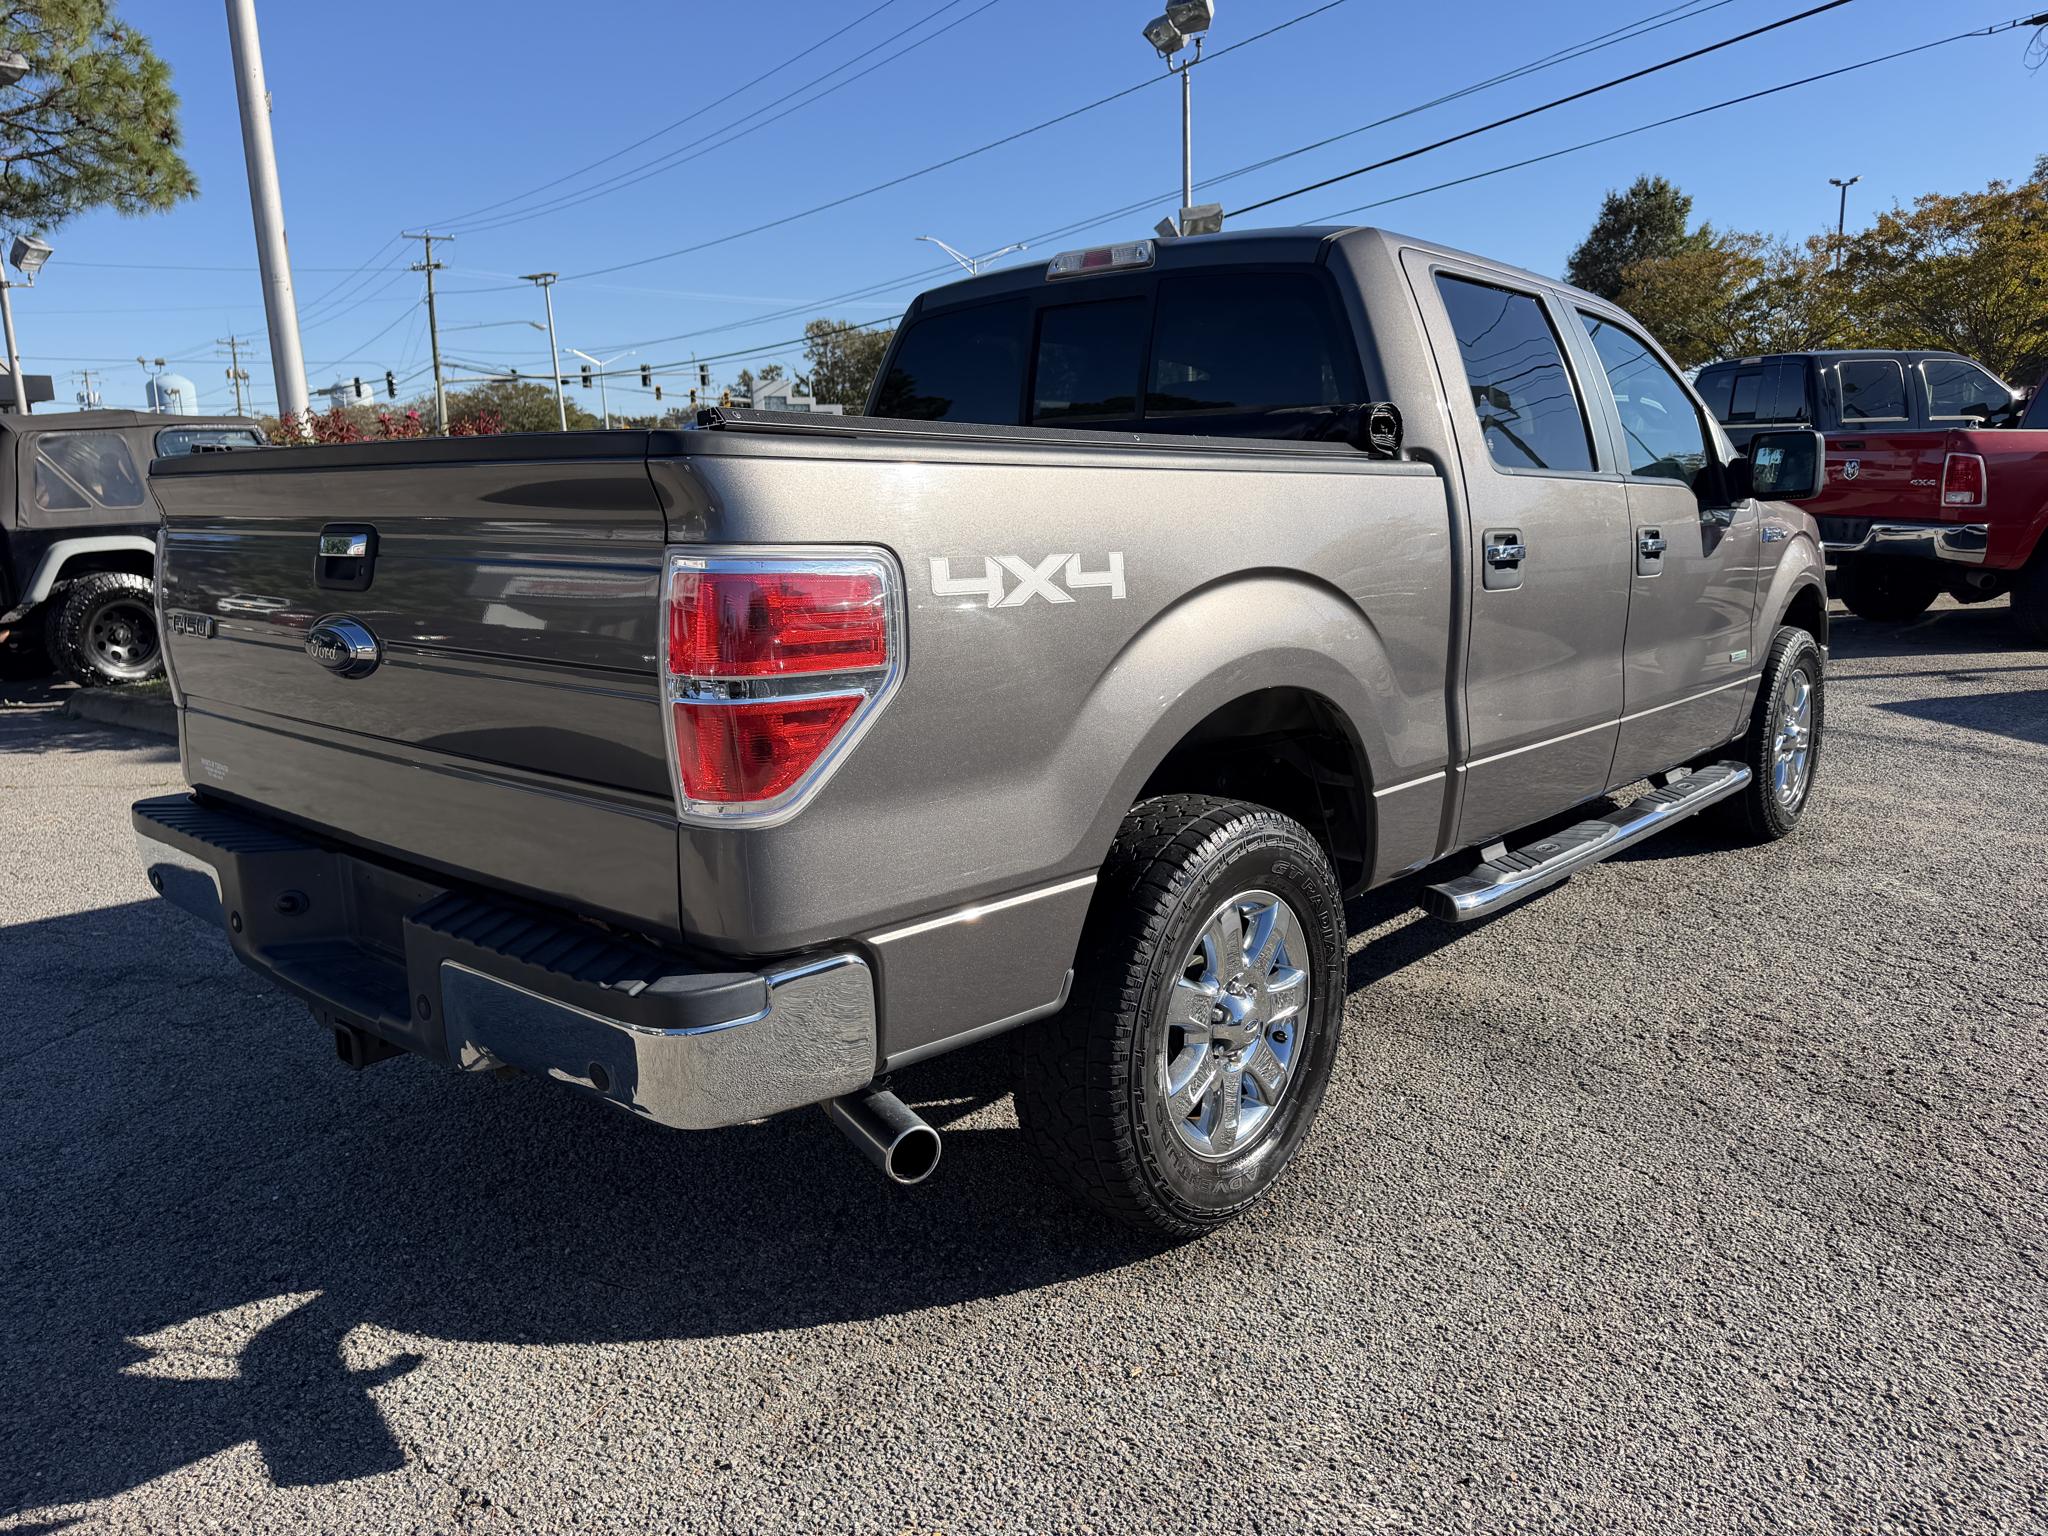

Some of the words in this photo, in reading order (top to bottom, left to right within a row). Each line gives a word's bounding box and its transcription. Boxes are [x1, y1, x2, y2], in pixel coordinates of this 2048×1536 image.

[311, 634, 338, 660] Ford
[1271, 860, 1305, 880] GT
[1301, 876, 1337, 982] RADIAL
